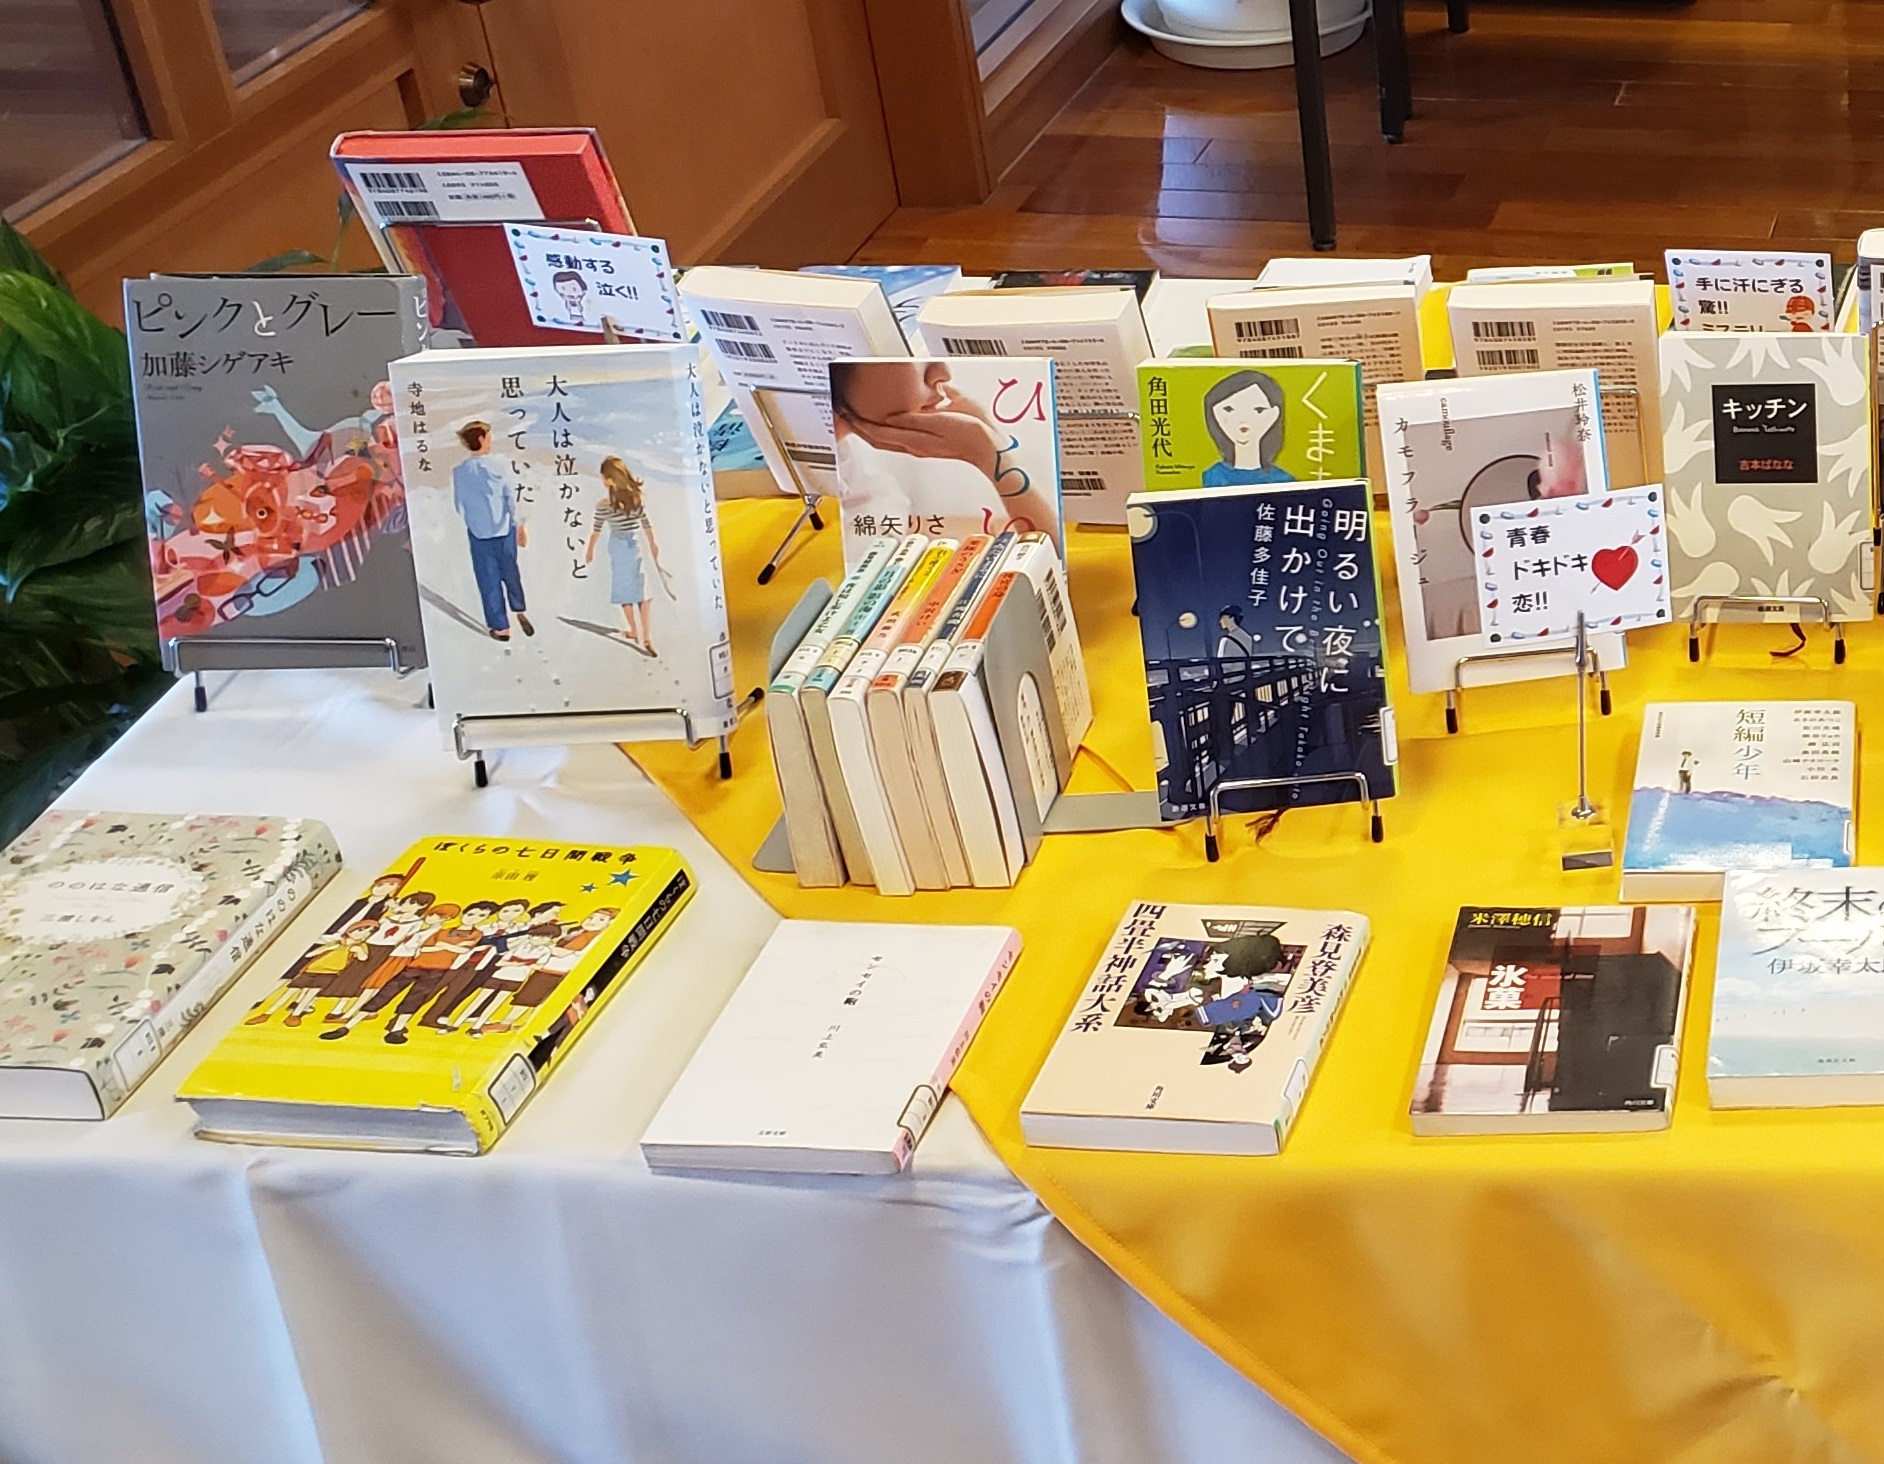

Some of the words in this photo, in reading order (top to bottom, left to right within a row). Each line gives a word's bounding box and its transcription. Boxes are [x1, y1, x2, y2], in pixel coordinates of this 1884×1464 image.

[546, 252, 616, 275] 感動する
[1695, 277, 1805, 295] 手に汗にぎる
[134, 291, 397, 340] ピンクとグレー
[413, 289, 429, 351] ピン
[140, 351, 295, 378] 加藤シゲアキ
[407, 381, 433, 473] 寺地はるな
[1147, 376, 1173, 459] 角田光代
[1572, 383, 1593, 442] 松井玲奈
[1722, 397, 1808, 420] キッチン
[500, 376, 535, 504] 思っていた
[1739, 459, 1794, 471] 吉本ばなな
[546, 374, 589, 580] 大人は泣かないと
[685, 361, 725, 610] 大人は泣かないと思っていた
[1393, 416, 1431, 586] カモフラージュ
[854, 513, 947, 537] 綿矢りさ
[1315, 498, 1334, 541] Going
[1506, 525, 1550, 548] 青春
[1248, 502, 1276, 607] 佐藤多佳子
[1275, 504, 1316, 653] 出かけて
[1315, 548, 1329, 571] Out
[1513, 554, 1589, 581] ドキドキ
[1320, 508, 1368, 694] 明るい夜に
[1733, 708, 1768, 781] 短編少年
[434, 841, 638, 866] ぼくらの七日間戦争
[48, 882, 175, 894] ののはな通信
[229, 887, 297, 964] ののはな通信
[1469, 912, 1554, 928] 米澤穂信
[843, 954, 883, 1006] センセイの鞄
[1070, 903, 1168, 1033] 四畳半神話大系
[1287, 923, 1354, 1016] 森見登美彦
[1484, 964, 1529, 1010] 氷菓
